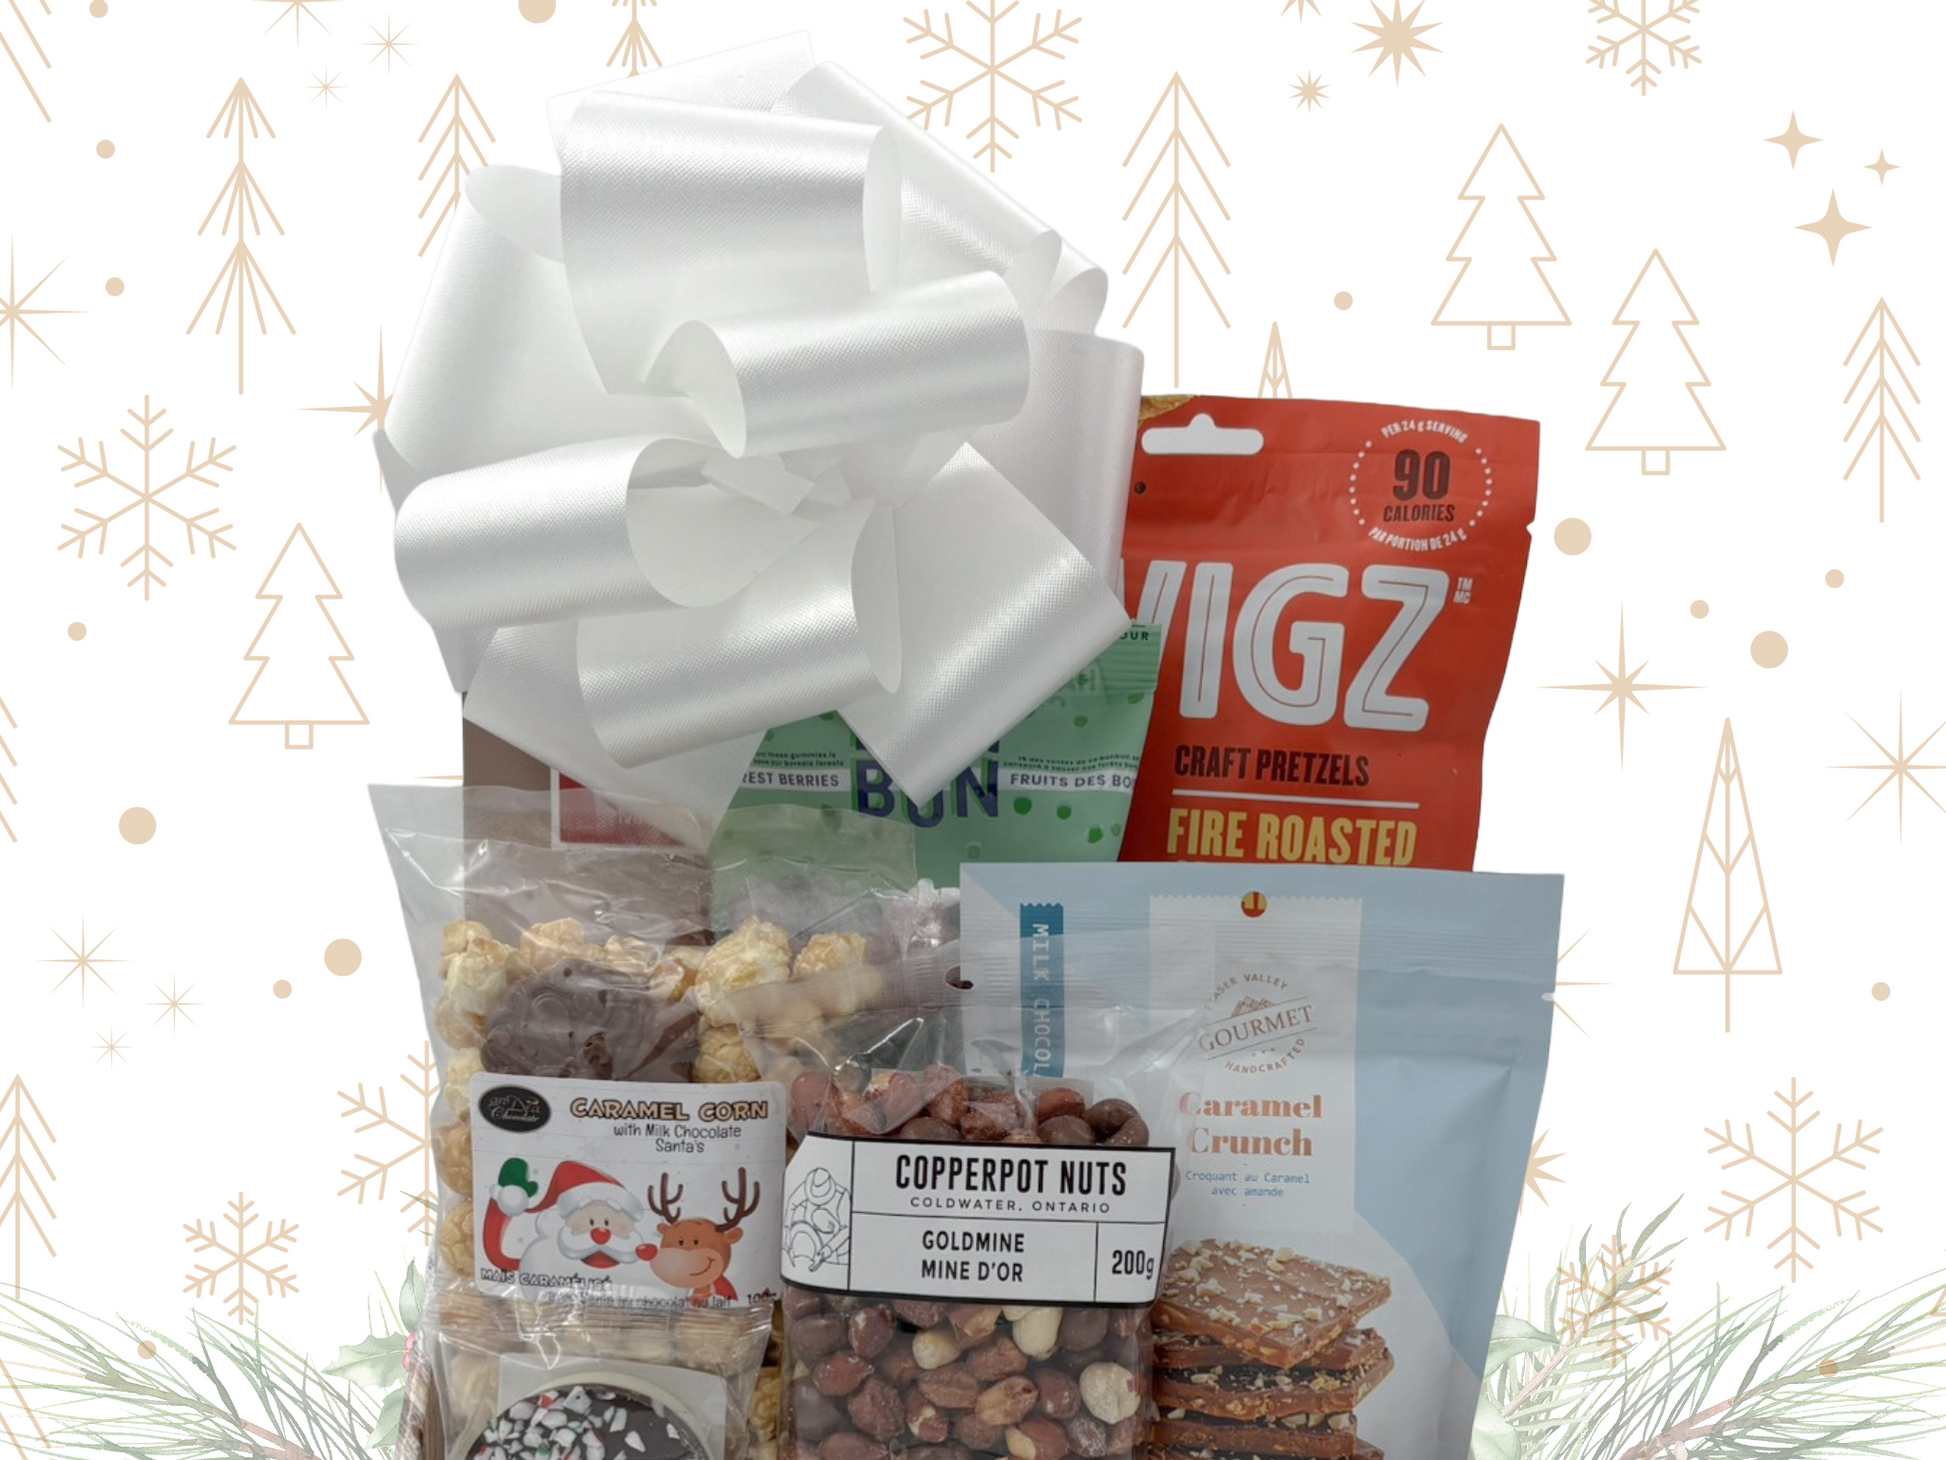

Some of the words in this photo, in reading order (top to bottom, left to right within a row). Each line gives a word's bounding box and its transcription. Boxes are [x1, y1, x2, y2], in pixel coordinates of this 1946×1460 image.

[1381, 422, 1402, 438] PER
[1401, 419, 1415, 432] 24
[1426, 420, 1468, 443] SERVING
[1393, 448, 1450, 501] 90
[1383, 504, 1455, 522] CALORIES
[1368, 526, 1385, 543] PAR
[1385, 535, 1429, 551] PORTION
[1429, 535, 1443, 551] DE
[1443, 532, 1458, 545] 24
[1458, 577, 1473, 590] TM
[1174, 745, 1251, 779] CRAFT
[1255, 749, 1369, 787] PRETZELS
[778, 773, 839, 787] BERRIES
[1010, 773, 1068, 787] FRUITS
[1075, 774, 1106, 787] DES
[1112, 774, 1136, 788] BO
[1167, 808, 1247, 857] FIRE
[1256, 813, 1417, 866] ROASTED
[1032, 923, 1049, 981] MILK
[1243, 973, 1288, 990] VALLEY
[1034, 999, 1051, 1077] CHOCOL
[1199, 1004, 1312, 1052] GOURMET
[1225, 1038, 1305, 1074] HANDCRAFTED
[570, 1097, 690, 1121] CARAMEL
[698, 1100, 769, 1122] CORN
[1179, 1091, 1323, 1119] Caramel
[613, 1122, 642, 1137] with
[645, 1122, 671, 1137] Milk
[674, 1124, 742, 1139] Chocolate
[1187, 1127, 1313, 1156] Crunch
[655, 1137, 705, 1153] Santa's
[896, 1155, 1048, 1194] COPPERPOT
[1060, 1160, 1127, 1196] NUTS
[1185, 1170, 1238, 1182] Croquant
[1244, 1173, 1258, 1182] au
[1264, 1172, 1310, 1184] Caramel
[1211, 1186, 1238, 1196] avec
[1244, 1186, 1284, 1198] amande
[1032, 1200, 1111, 1214] ONTARIO
[922, 1230, 1025, 1252] GOLDMINE
[921, 1259, 970, 1280] MINE
[978, 1262, 1023, 1282] D'OR
[1112, 1250, 1155, 1280] 200g
